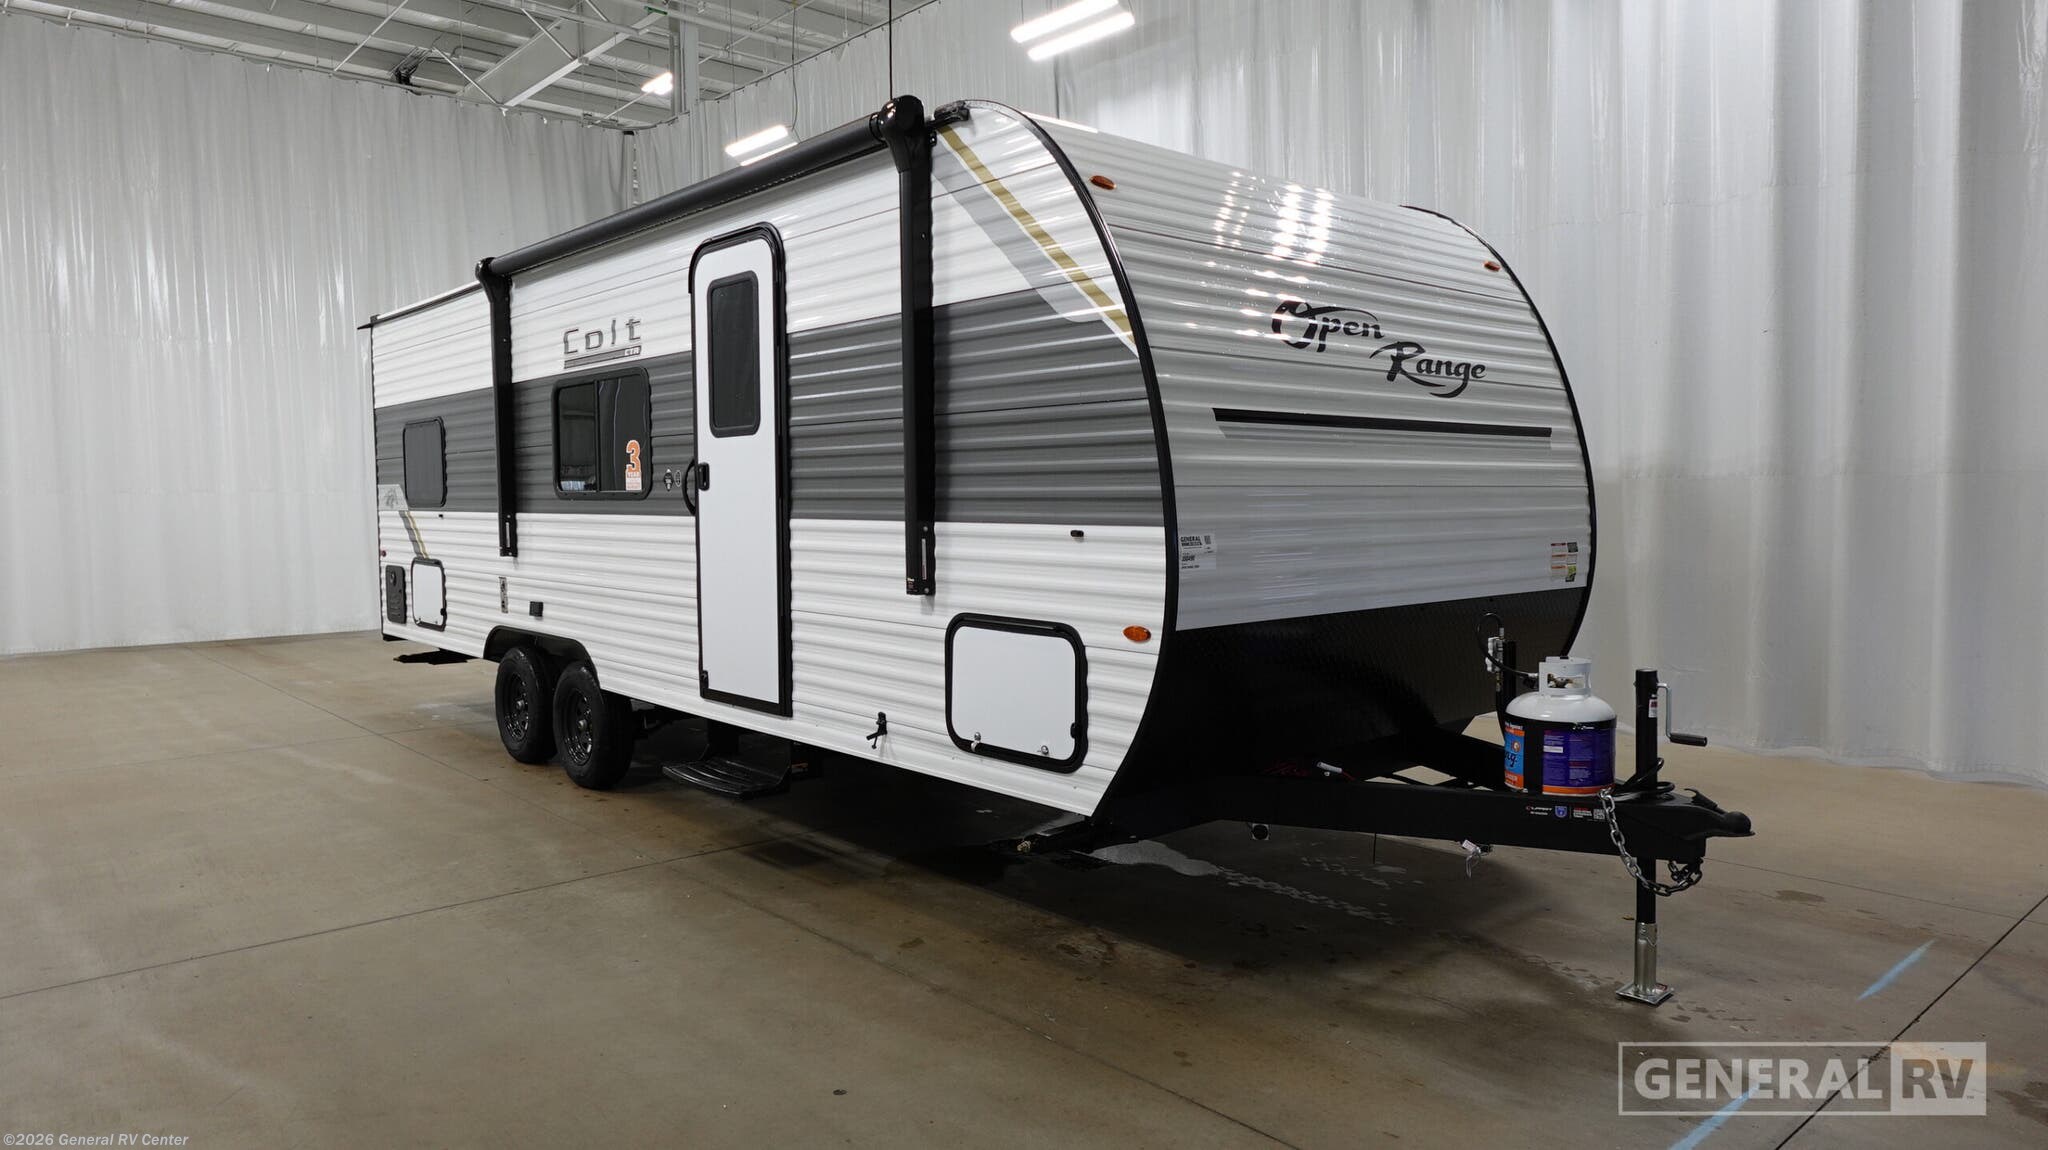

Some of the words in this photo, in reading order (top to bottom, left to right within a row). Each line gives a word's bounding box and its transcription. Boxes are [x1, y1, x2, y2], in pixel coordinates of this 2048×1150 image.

[563, 318, 641, 354] Colt
[1271, 300, 1384, 353] Open
[1369, 341, 1487, 398] Range
[625, 439, 641, 473] 3
